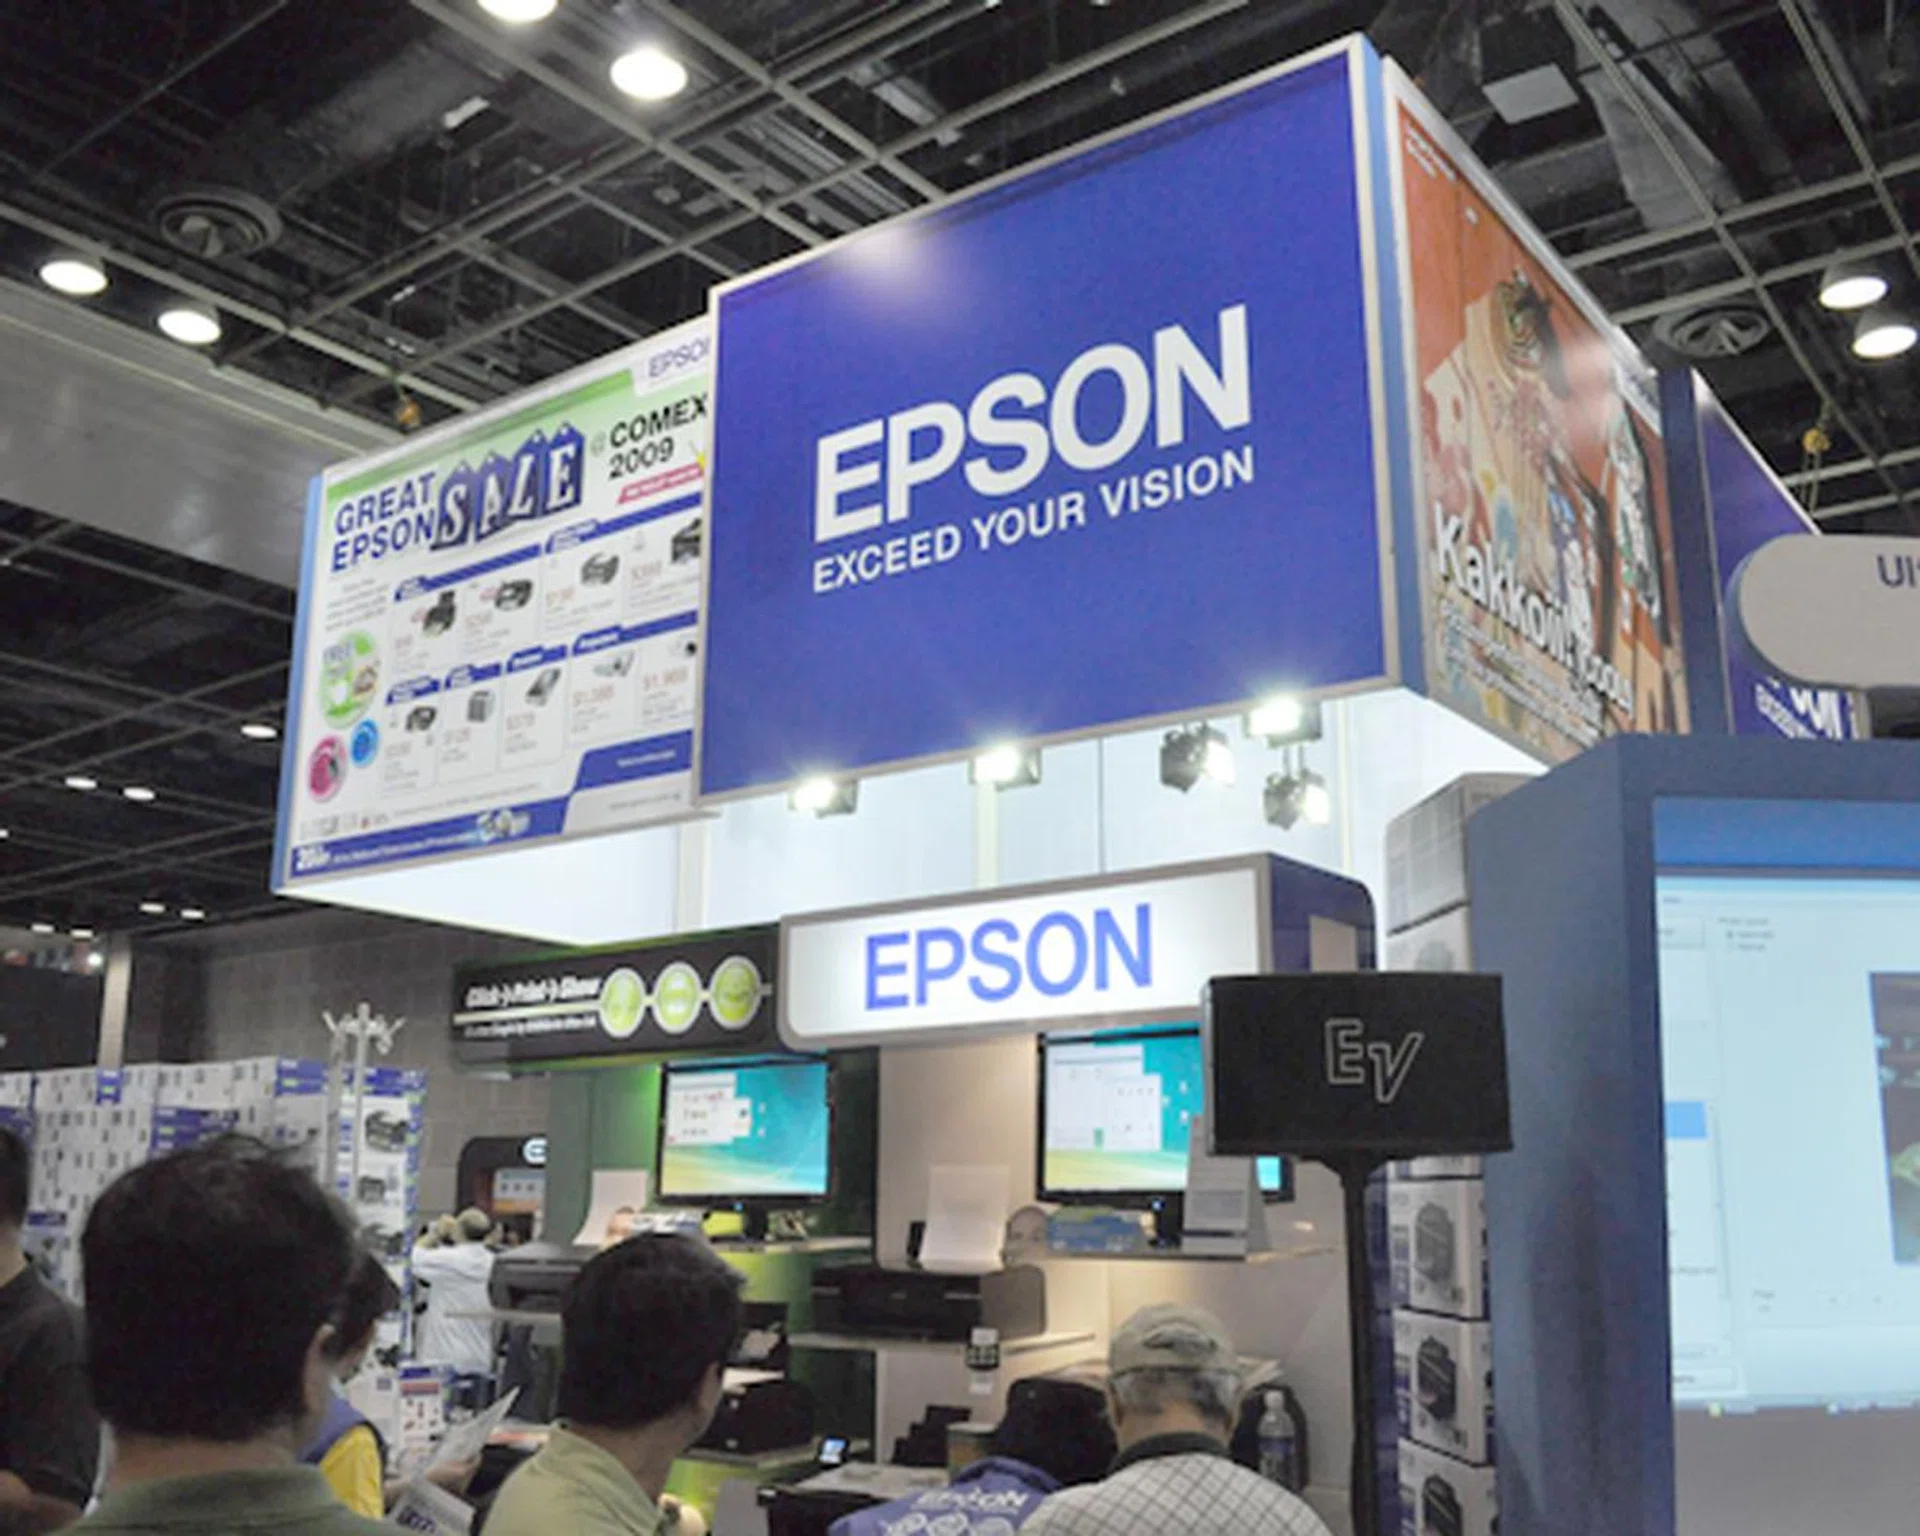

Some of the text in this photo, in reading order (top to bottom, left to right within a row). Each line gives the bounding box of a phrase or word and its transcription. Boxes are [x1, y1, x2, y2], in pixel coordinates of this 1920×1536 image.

[648, 336, 711, 378] EPSO
[610, 392, 708, 449] COMEX
[815, 304, 1252, 543] EPSON
[608, 435, 675, 480] 2009
[335, 472, 435, 535] GREAT
[437, 443, 578, 546] SALE
[813, 445, 1255, 594] EXCEED YOUR VISION
[331, 510, 435, 573] EPSON
[864, 903, 1153, 1010] EPSON
